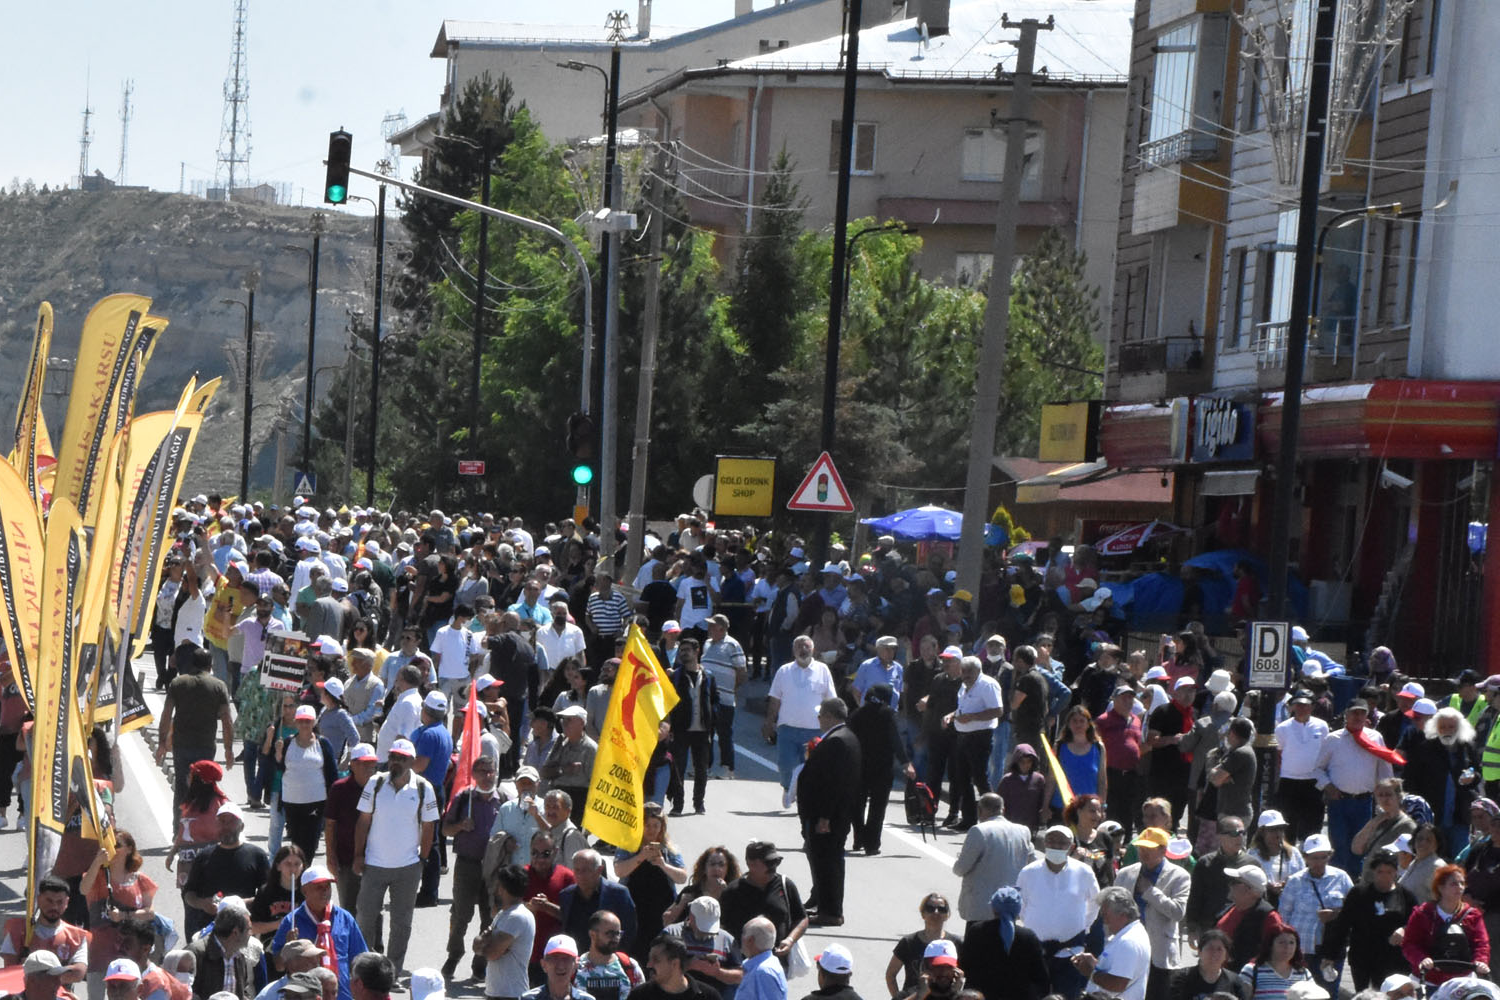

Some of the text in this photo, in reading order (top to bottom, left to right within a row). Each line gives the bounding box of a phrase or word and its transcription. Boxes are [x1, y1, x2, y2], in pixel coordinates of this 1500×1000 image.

[732, 489, 756, 498] SHOP
[1258, 627, 1280, 658] D
[1256, 658, 1281, 671] 608
